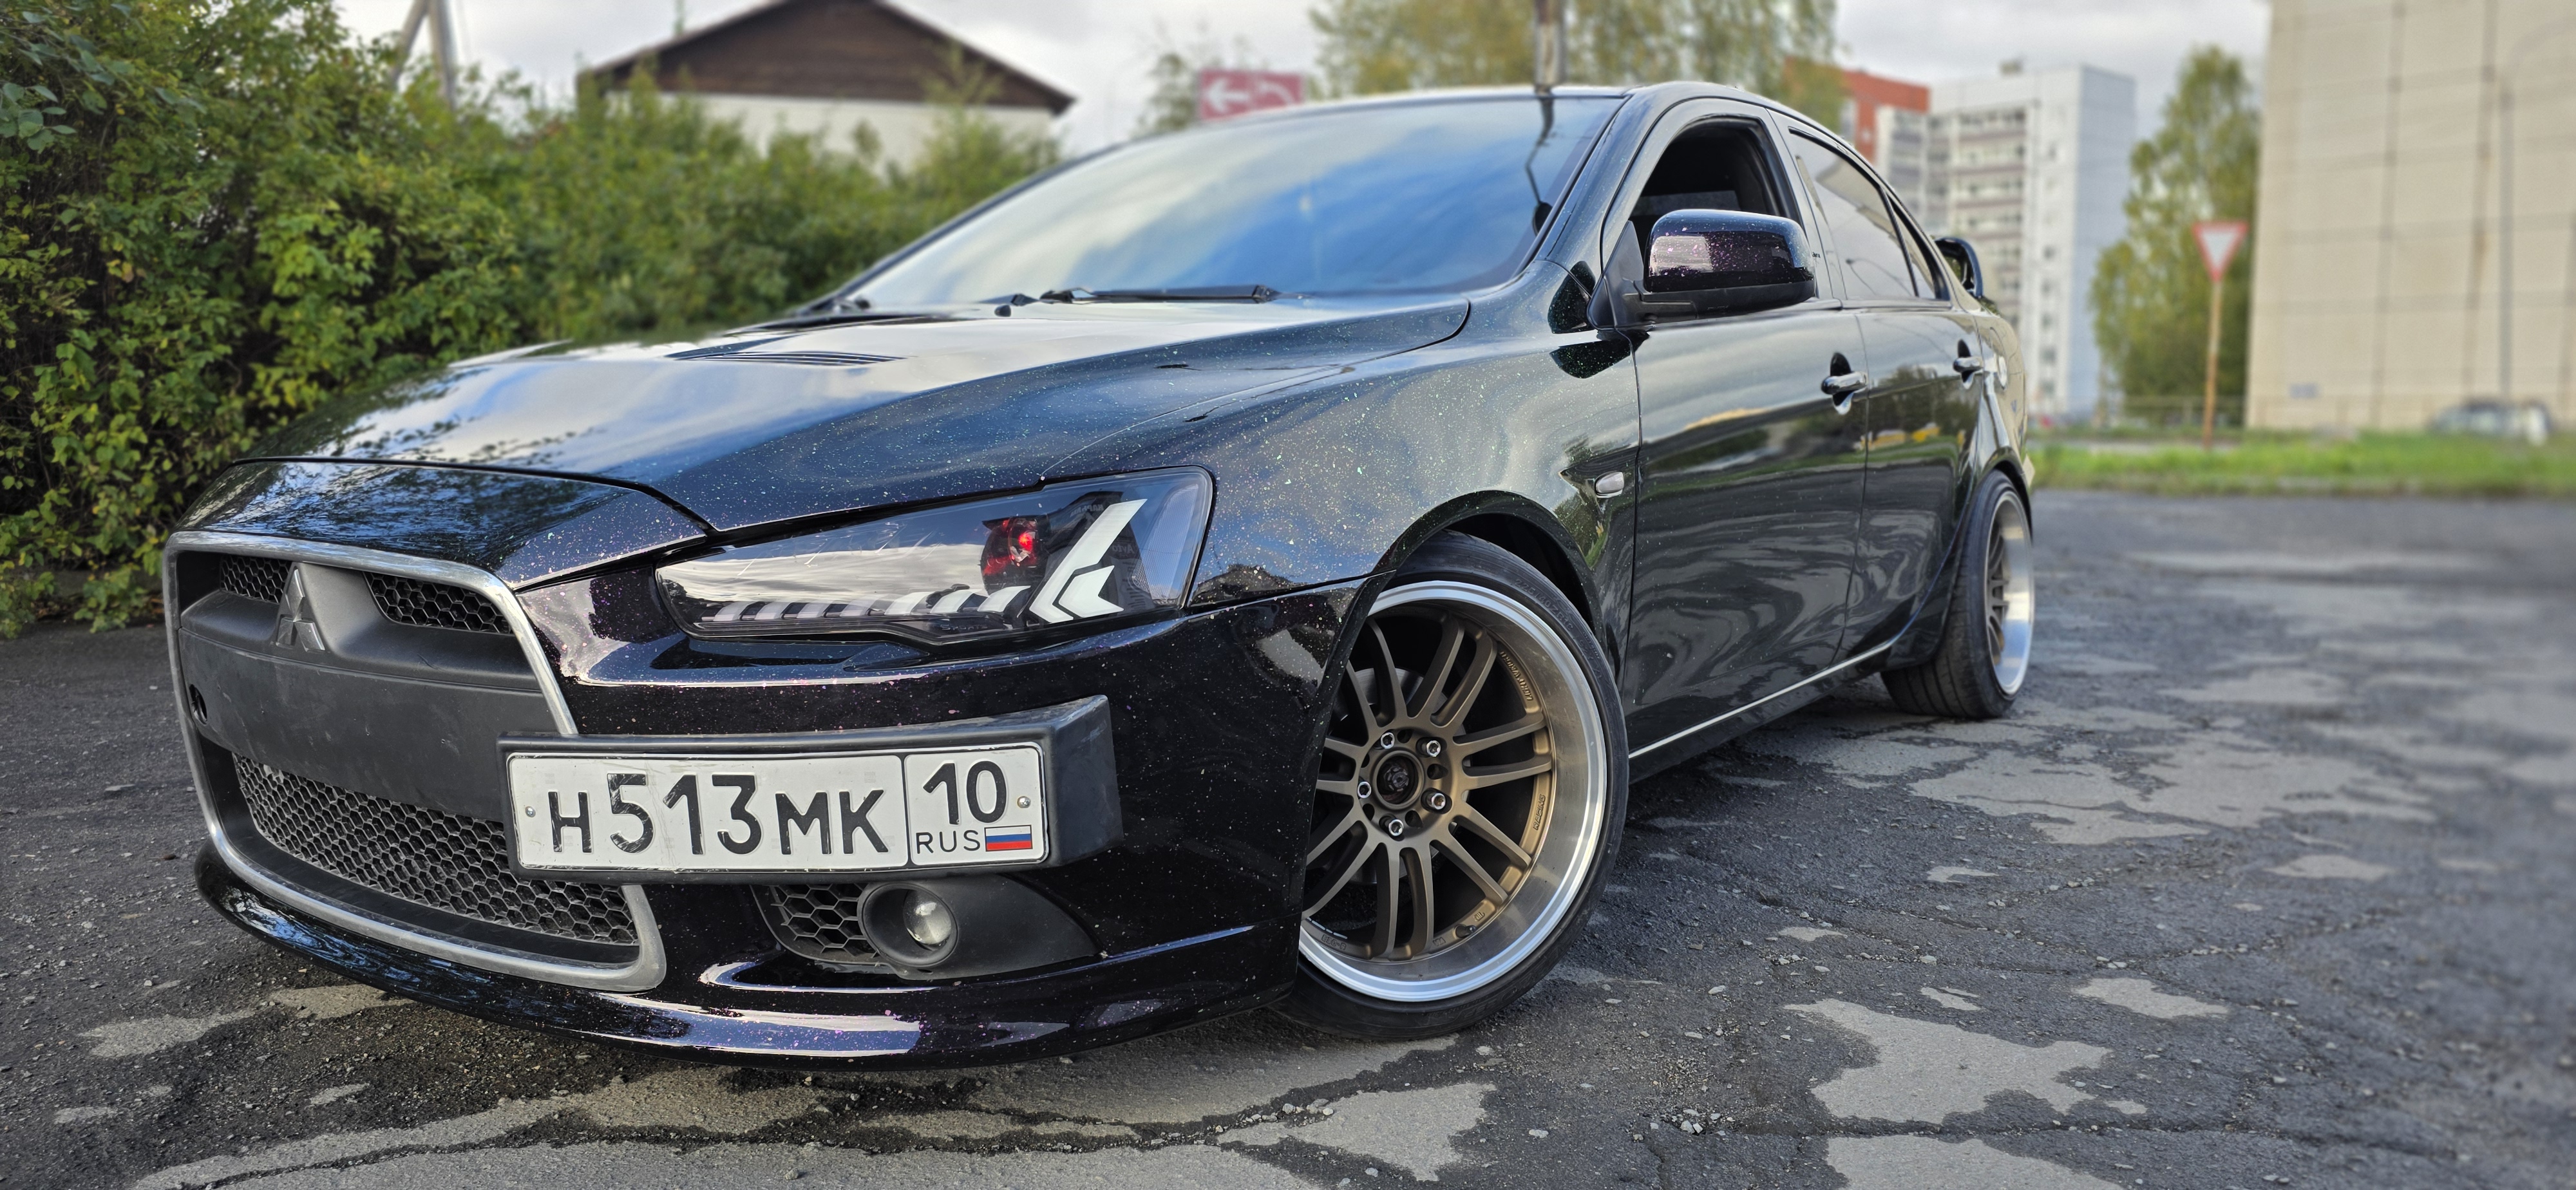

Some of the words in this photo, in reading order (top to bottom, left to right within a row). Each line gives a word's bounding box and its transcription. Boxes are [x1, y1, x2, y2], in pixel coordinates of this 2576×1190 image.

[922, 760, 1007, 825] 10
[1533, 793, 1546, 831] RACING
[916, 830, 981, 855] RUS
